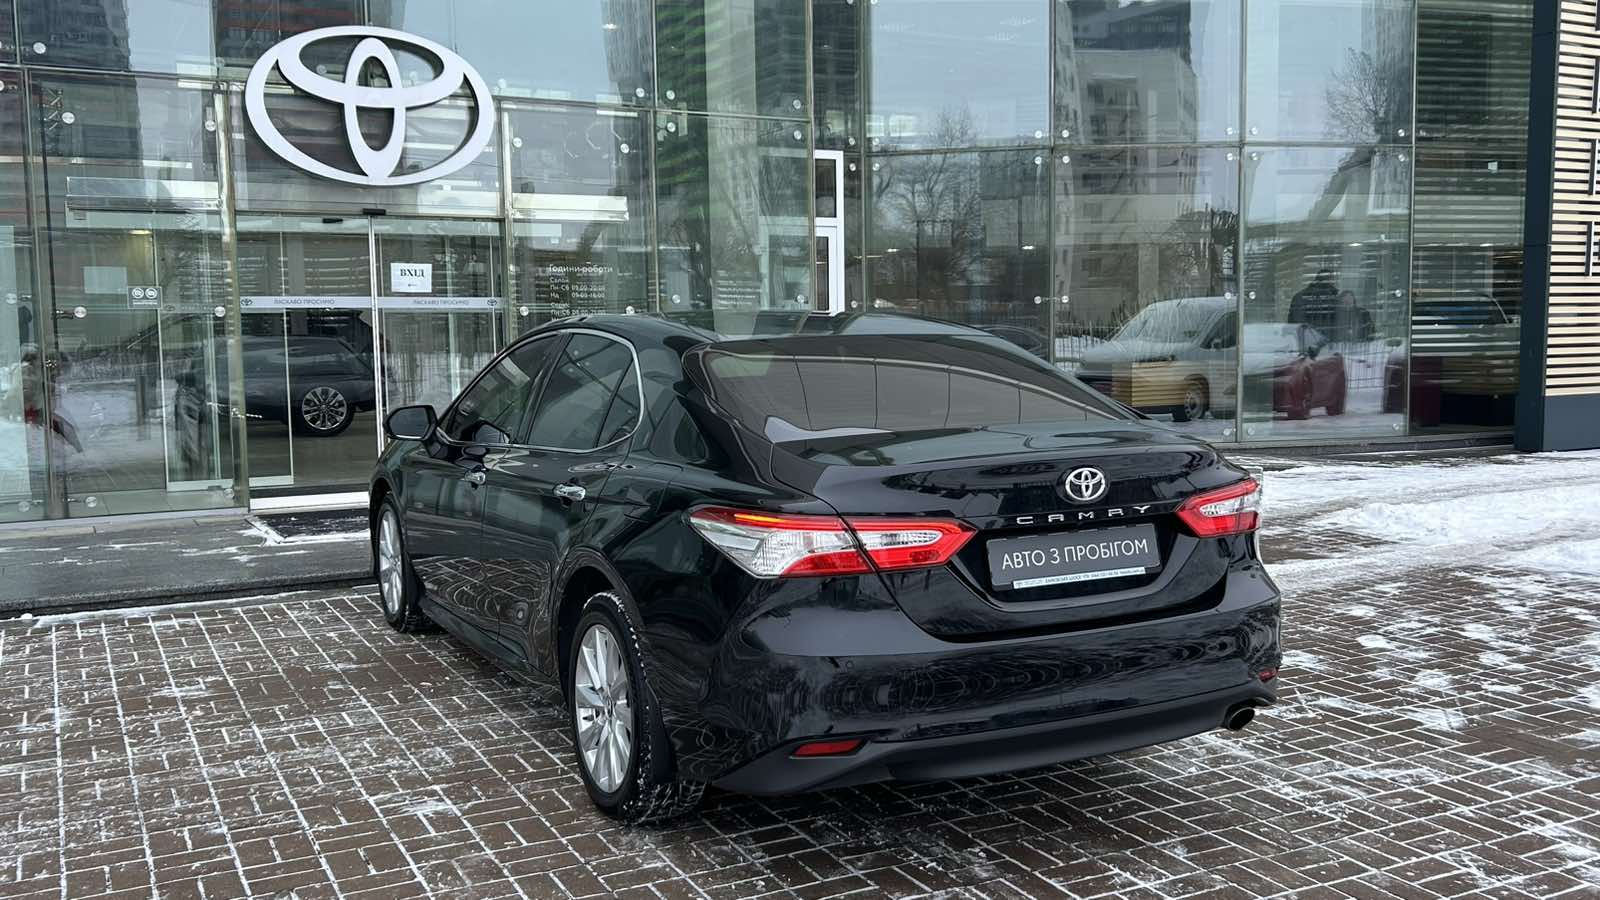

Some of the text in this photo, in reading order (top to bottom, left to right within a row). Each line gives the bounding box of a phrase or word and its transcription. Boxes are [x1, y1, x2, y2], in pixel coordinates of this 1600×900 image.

[1016, 505, 1151, 525] CAMRY
[1002, 549, 1046, 570] АВТО
[1064, 538, 1149, 563] ПРОБІГОМ
